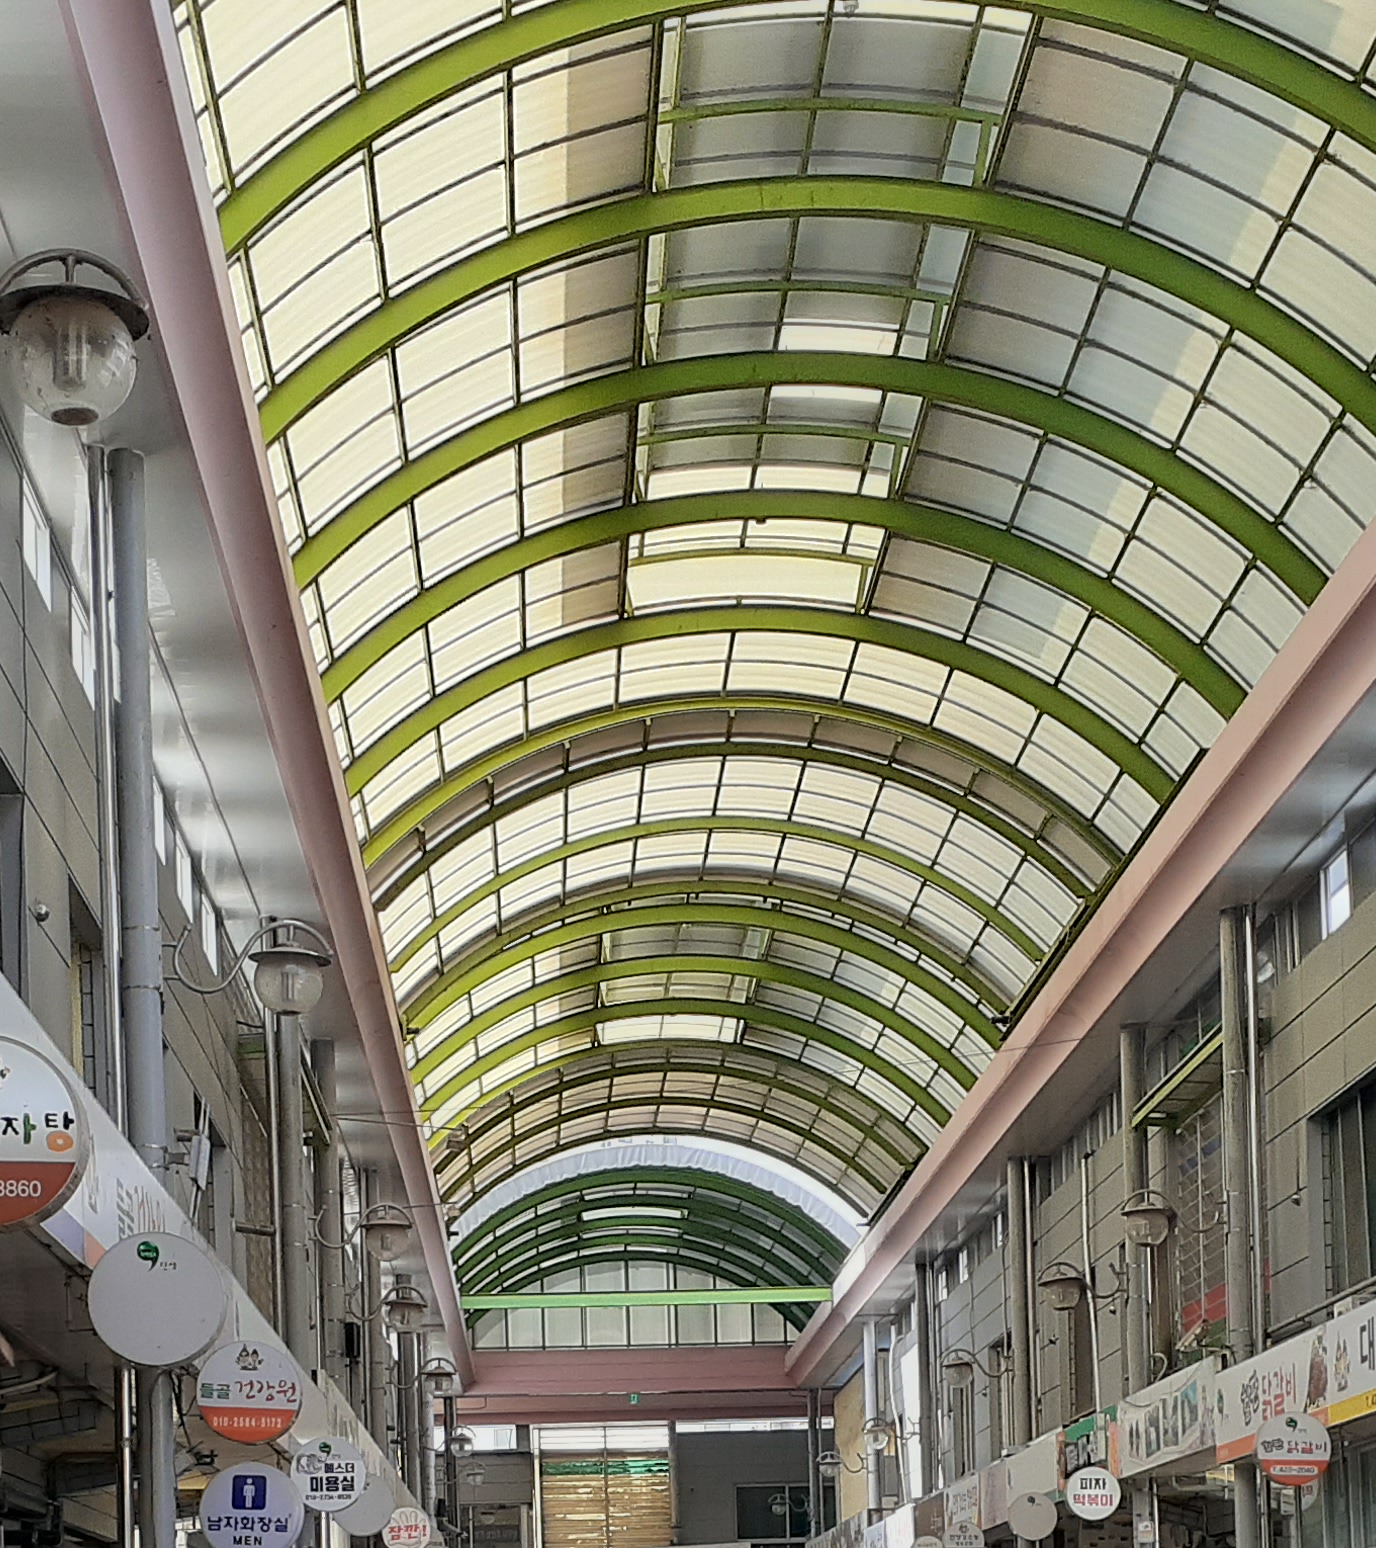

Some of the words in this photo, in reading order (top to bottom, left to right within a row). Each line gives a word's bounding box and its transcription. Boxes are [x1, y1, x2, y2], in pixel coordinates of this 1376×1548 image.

[235, 1379, 297, 1403] 건강원
[310, 1476, 355, 1492] 미용실
[207, 1516, 289, 1533] 남자화장실
[233, 1536, 263, 1546] MEN
